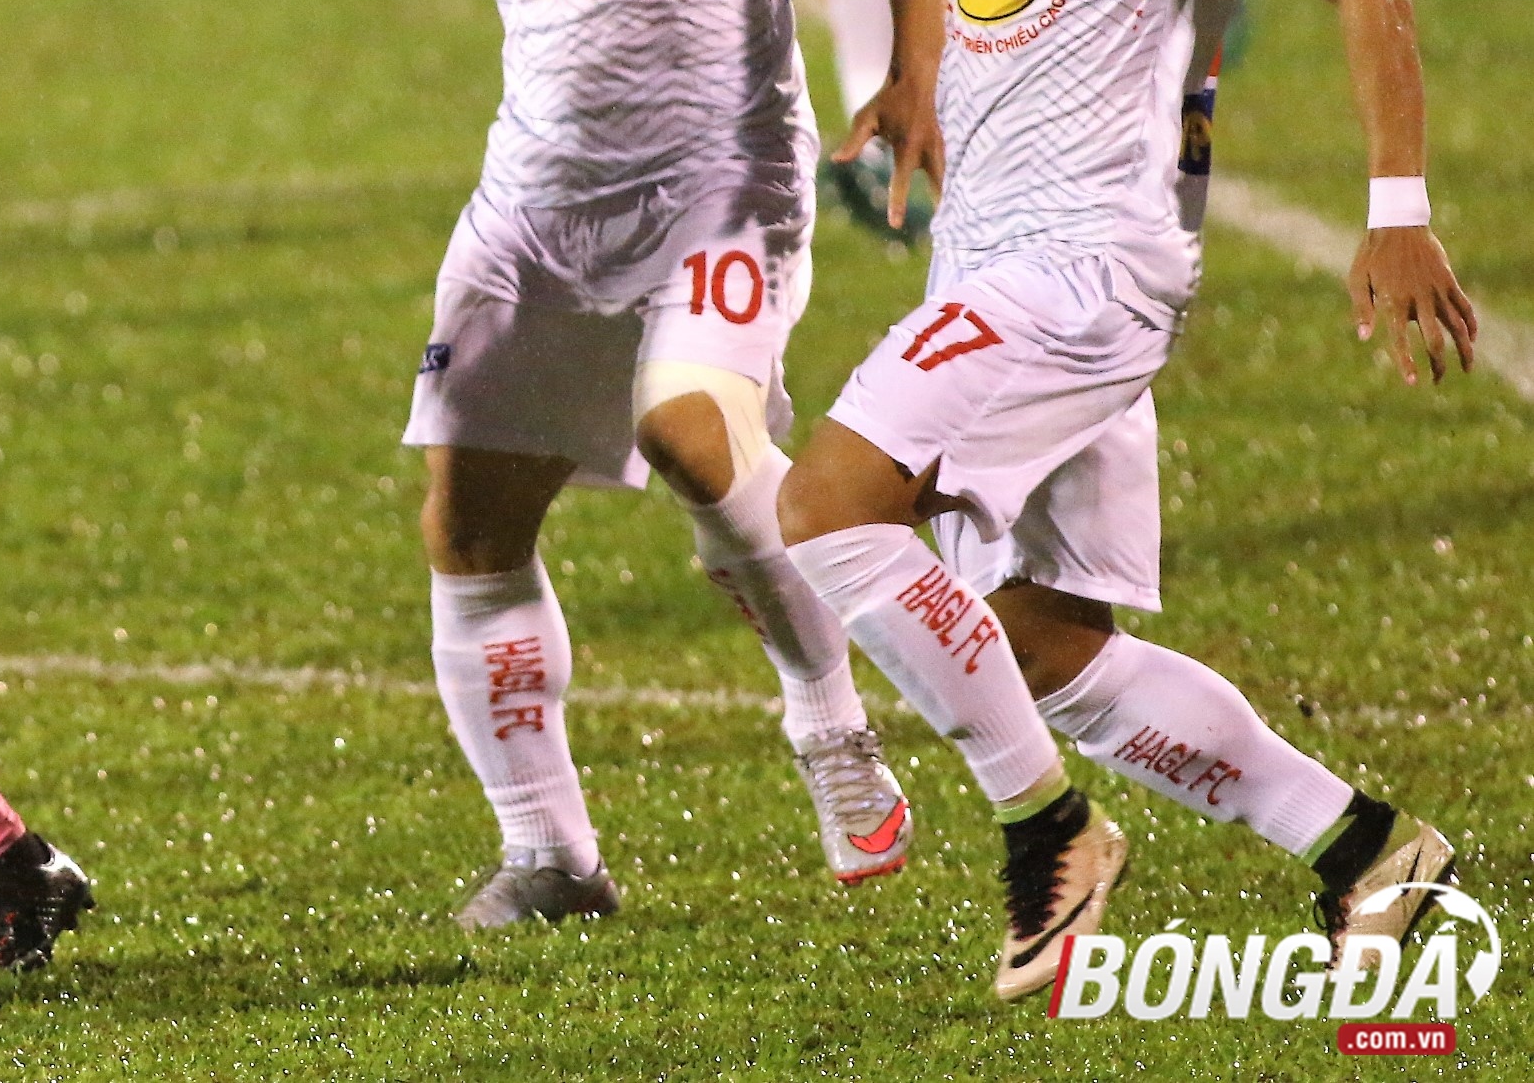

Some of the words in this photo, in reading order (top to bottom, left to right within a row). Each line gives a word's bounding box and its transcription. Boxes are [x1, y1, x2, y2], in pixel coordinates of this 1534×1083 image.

[682, 249, 765, 324] 10
[901, 302, 1005, 372] 17
[896, 564, 973, 647] HAGL
[951, 615, 999, 675] FC
[483, 636, 545, 704] HAGL
[492, 704, 544, 741] FC
[1114, 725, 1202, 785] HAGL
[1187, 759, 1242, 806] FC
